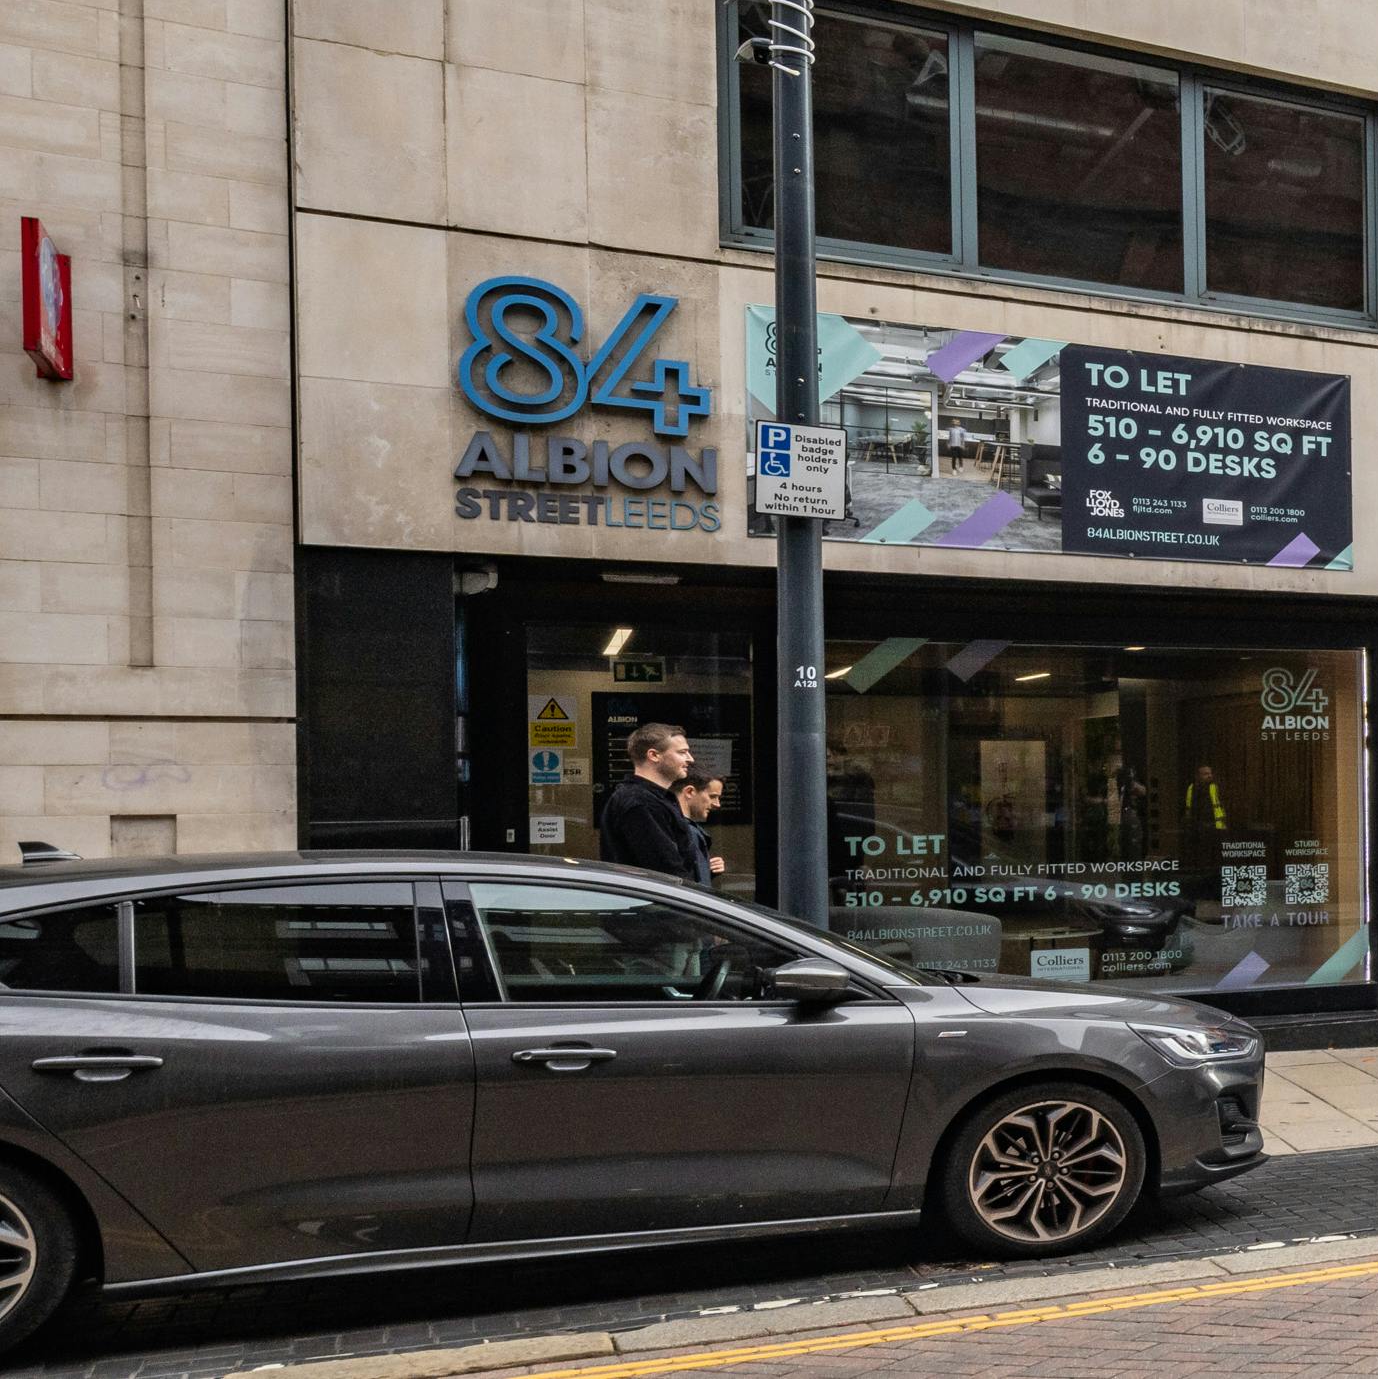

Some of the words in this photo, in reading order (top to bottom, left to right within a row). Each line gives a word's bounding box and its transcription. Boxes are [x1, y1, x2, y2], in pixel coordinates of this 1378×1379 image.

[458, 275, 712, 437] 84
[1085, 362, 1130, 389] TO
[1140, 369, 1191, 396] LET
[1085, 397, 1162, 414] TRADITIONAL
[1165, 406, 1190, 417] AND
[1193, 408, 1225, 421] FULLY
[1227, 412, 1264, 424] FITTED
[1266, 416, 1332, 431] WORKSPACE
[768, 428, 787, 447] P
[794, 434, 842, 447] Disabled
[1087, 414, 1138, 439] 510
[1171, 423, 1245, 449] 6,910
[1253, 430, 1293, 455] SQ
[1302, 435, 1332, 456] FT
[801, 444, 834, 456] badge
[454, 431, 718, 495] ALBION
[797, 453, 838, 465] holders
[1087, 442, 1105, 465] 6
[1139, 447, 1177, 471] 90
[1187, 451, 1277, 479] DESKS
[806, 464, 830, 474] only
[791, 483, 822, 493] hours
[774, 492, 790, 502] No
[793, 495, 828, 505] return
[1089, 489, 1112, 500] FOX
[764, 501, 799, 512] within
[803, 505, 807, 513] 1
[810, 505, 836, 516] hour
[1086, 498, 1120, 509] LLOYD
[1132, 497, 1151, 506] 0113
[1153, 499, 1168, 507] 243
[1170, 500, 1187, 509] 1133
[1206, 502, 1239, 513] Colliers
[1090, 506, 1124, 518] JONES
[1250, 513, 1298, 523] colliers.com
[1269, 507, 1285, 515] 200
[1287, 508, 1305, 517] 1800
[1087, 527, 1220, 547] 84ALBIONSTREET.CO.UK
[796, 665, 817, 679] 10
[794, 680, 818, 688] A128
[1260, 667, 1329, 713] 84
[534, 724, 572, 732] Caution
[1261, 715, 1329, 730] ALBION
[1261, 732, 1276, 741] ST
[1285, 731, 1329, 741] LEEDS
[844, 835, 886, 856] TO
[896, 834, 945, 855] LET
[1222, 842, 1266, 850] TRADITIONAL
[1294, 840, 1319, 848] STUDIO
[1222, 850, 1266, 858] WORKSPACE
[1285, 848, 1328, 856] WORKSPACE
[845, 867, 948, 881] TRADITIONAL
[952, 865, 986, 877] AND
[990, 864, 1033, 876] FULLY
[1037, 862, 1087, 874] FITTED
[1090, 860, 1180, 872] WORKSPACE
[845, 891, 884, 908] 510
[910, 888, 968, 907] 6,910
[974, 886, 1006, 904] SQ
[1013, 886, 1039, 901] FT
[1044, 884, 1057, 901] 6
[1080, 883, 1108, 899] 90
[1114, 881, 1181, 898] DESKS
[1221, 914, 1263, 929] TAKE
[1270, 913, 1279, 927] A
[1286, 911, 1329, 926] TOUR
[847, 925, 992, 942] 84ALBIONSTREET.CO.UK
[1036, 954, 1085, 966] Colliers
[1102, 952, 1128, 962] 0113
[1130, 951, 1153, 961] 200
[1156, 950, 1183, 960] 1800
[972, 958, 997, 968] 1133
[1102, 961, 1172, 972] colliers.com
